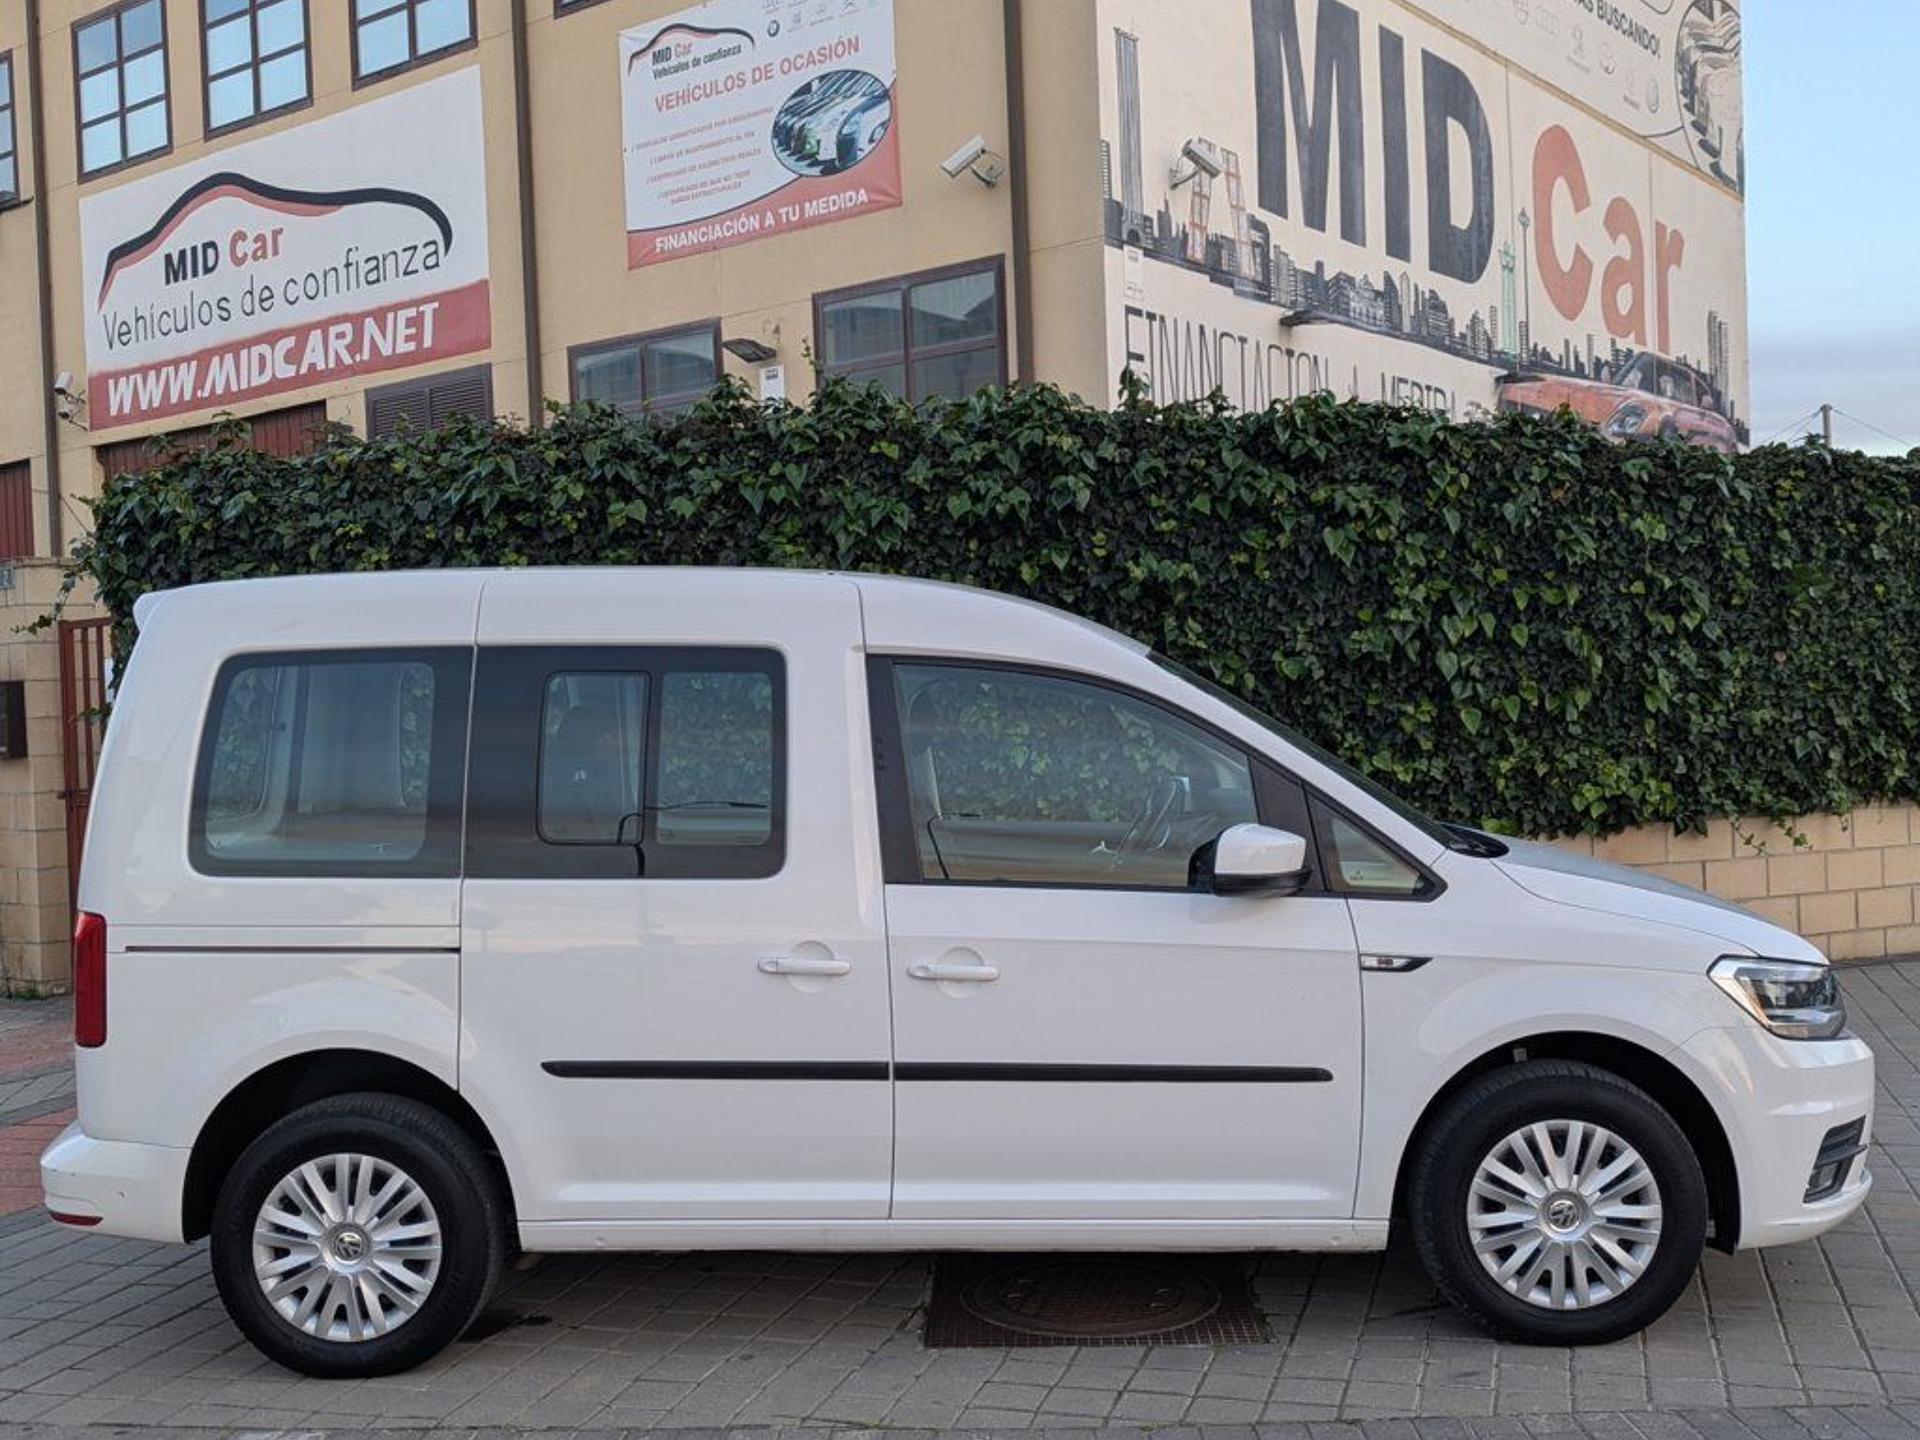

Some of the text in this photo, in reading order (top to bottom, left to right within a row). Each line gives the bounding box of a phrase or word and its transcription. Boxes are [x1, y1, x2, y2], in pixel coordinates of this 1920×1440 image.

[652, 42, 692, 66] MID Car
[655, 35, 860, 112] VEHÍCULOS DE OCASIÓN
[692, 56, 701, 68] de
[703, 44, 742, 65] confianza
[1250, 0, 1685, 356] MID Car
[655, 188, 869, 253] FINANCIACIÓN A TU MEDIDA
[164, 227, 284, 286] MID Car
[103, 239, 440, 350] Vehículos de confianza
[108, 302, 440, 417] WWW.MIDCAR.NET
